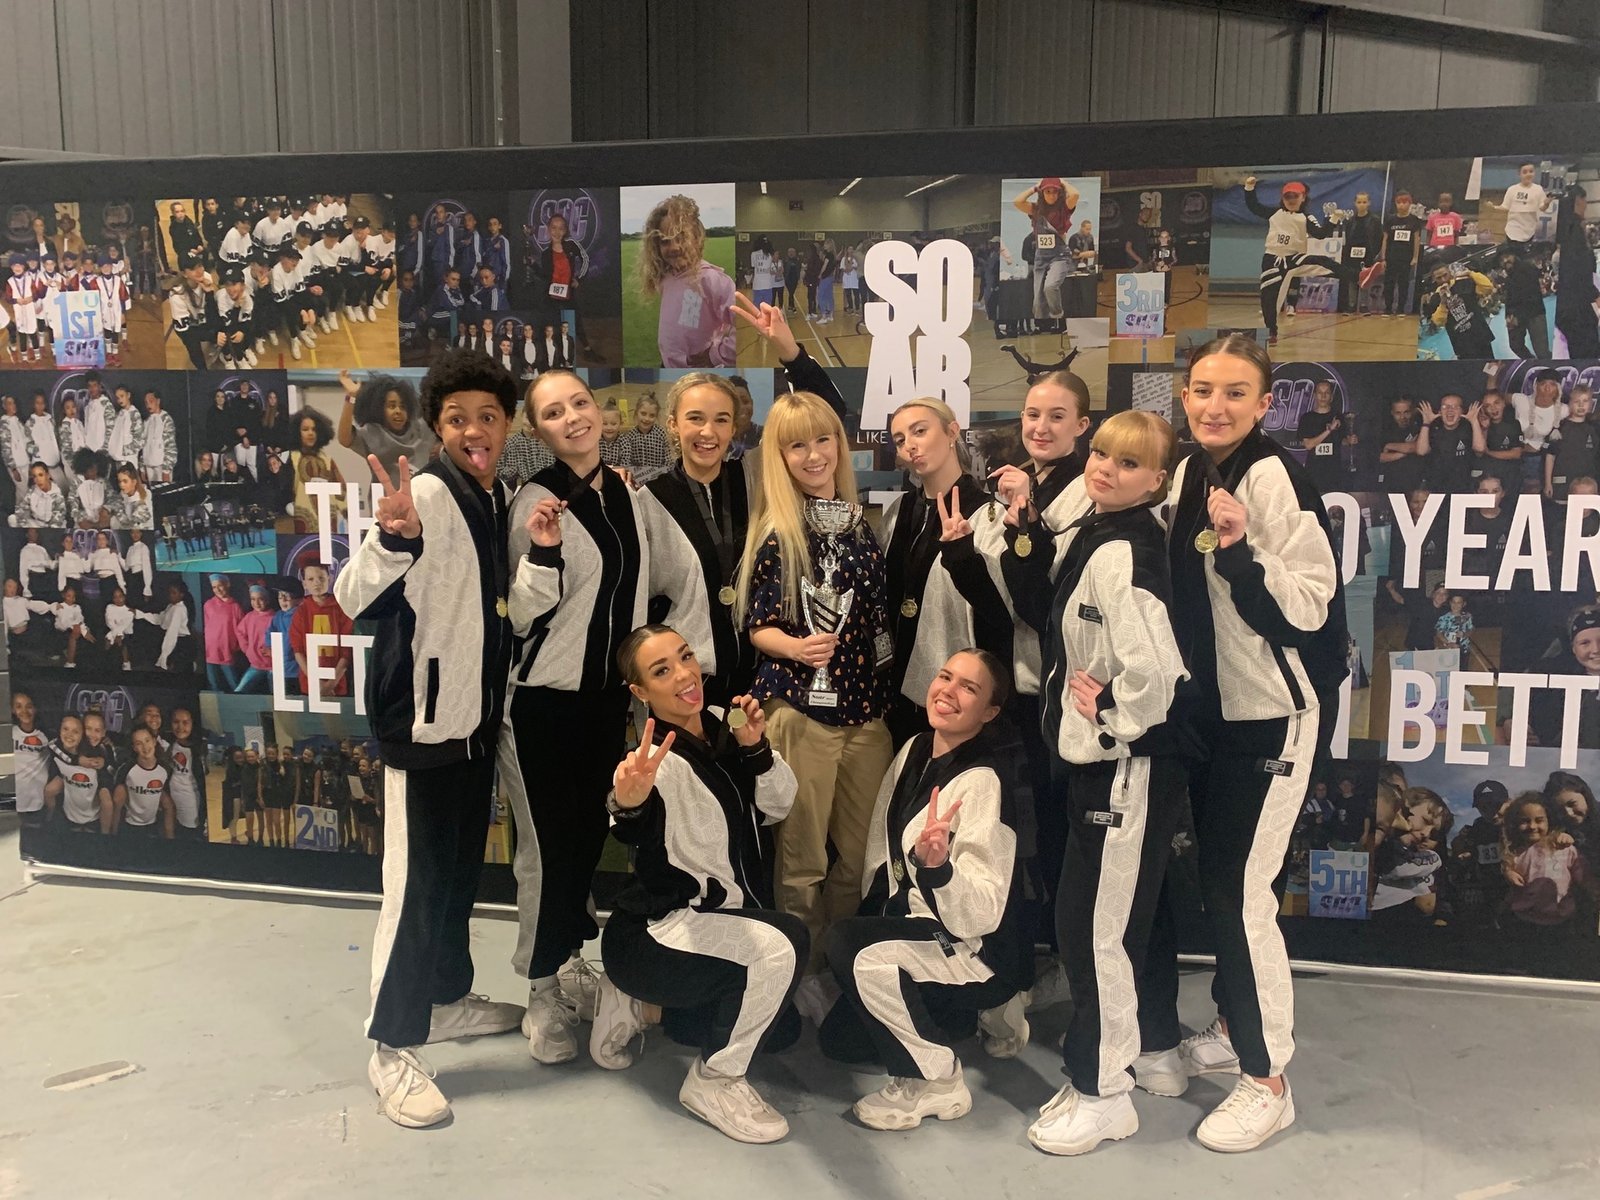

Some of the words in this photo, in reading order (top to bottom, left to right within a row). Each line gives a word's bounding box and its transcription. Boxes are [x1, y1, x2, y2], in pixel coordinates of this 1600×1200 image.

[1039, 236, 1053, 246] 523
[1277, 234, 1291, 245] 188
[552, 285, 565, 295] 187
[1118, 275, 1164, 312] 3RD
[54, 292, 97, 339] 1ST
[856, 430, 889, 444] LIKE
[1318, 445, 1330, 454] 413
[305, 482, 384, 565] TH
[1386, 669, 1600, 770] BETT
[296, 807, 338, 849] 2ND
[1311, 851, 1367, 895] 5TH
